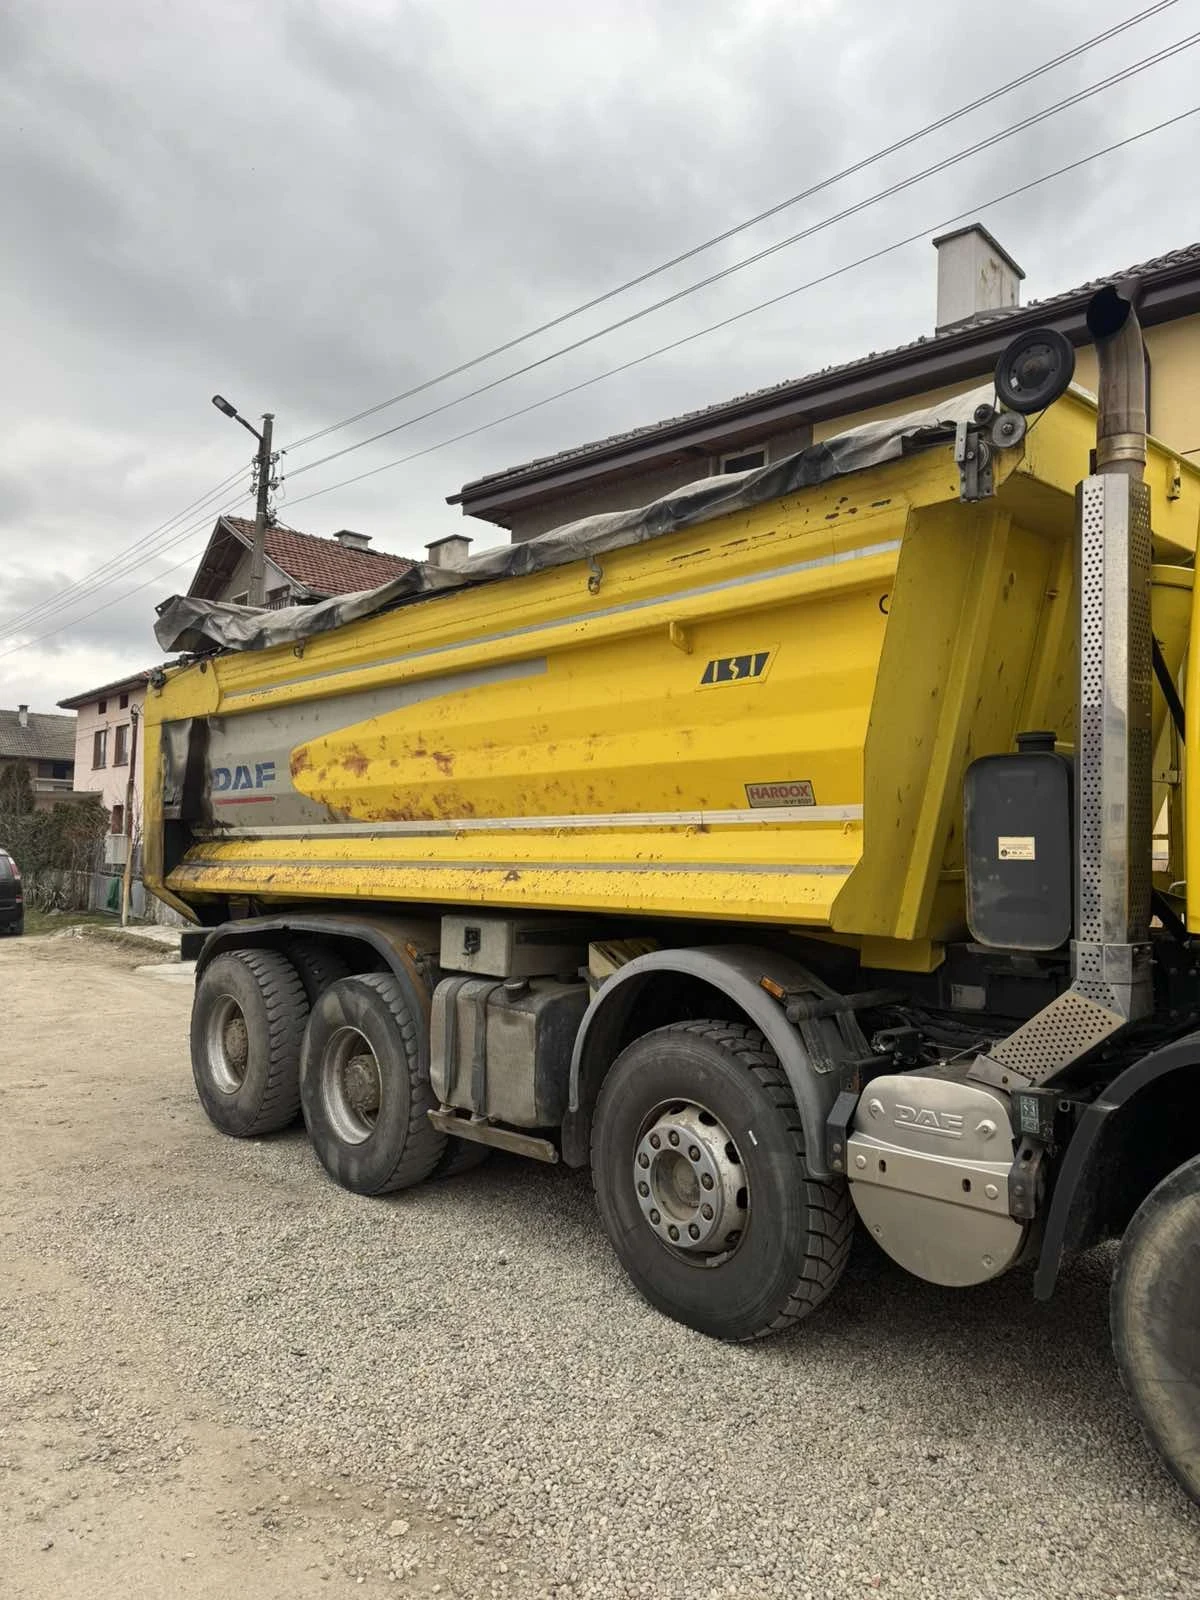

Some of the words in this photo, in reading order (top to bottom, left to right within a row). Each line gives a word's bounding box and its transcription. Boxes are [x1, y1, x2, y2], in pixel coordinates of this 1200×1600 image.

[211, 762, 276, 791] DAF
[750, 784, 810, 800] HARDOX
[895, 1104, 963, 1130] DAF
